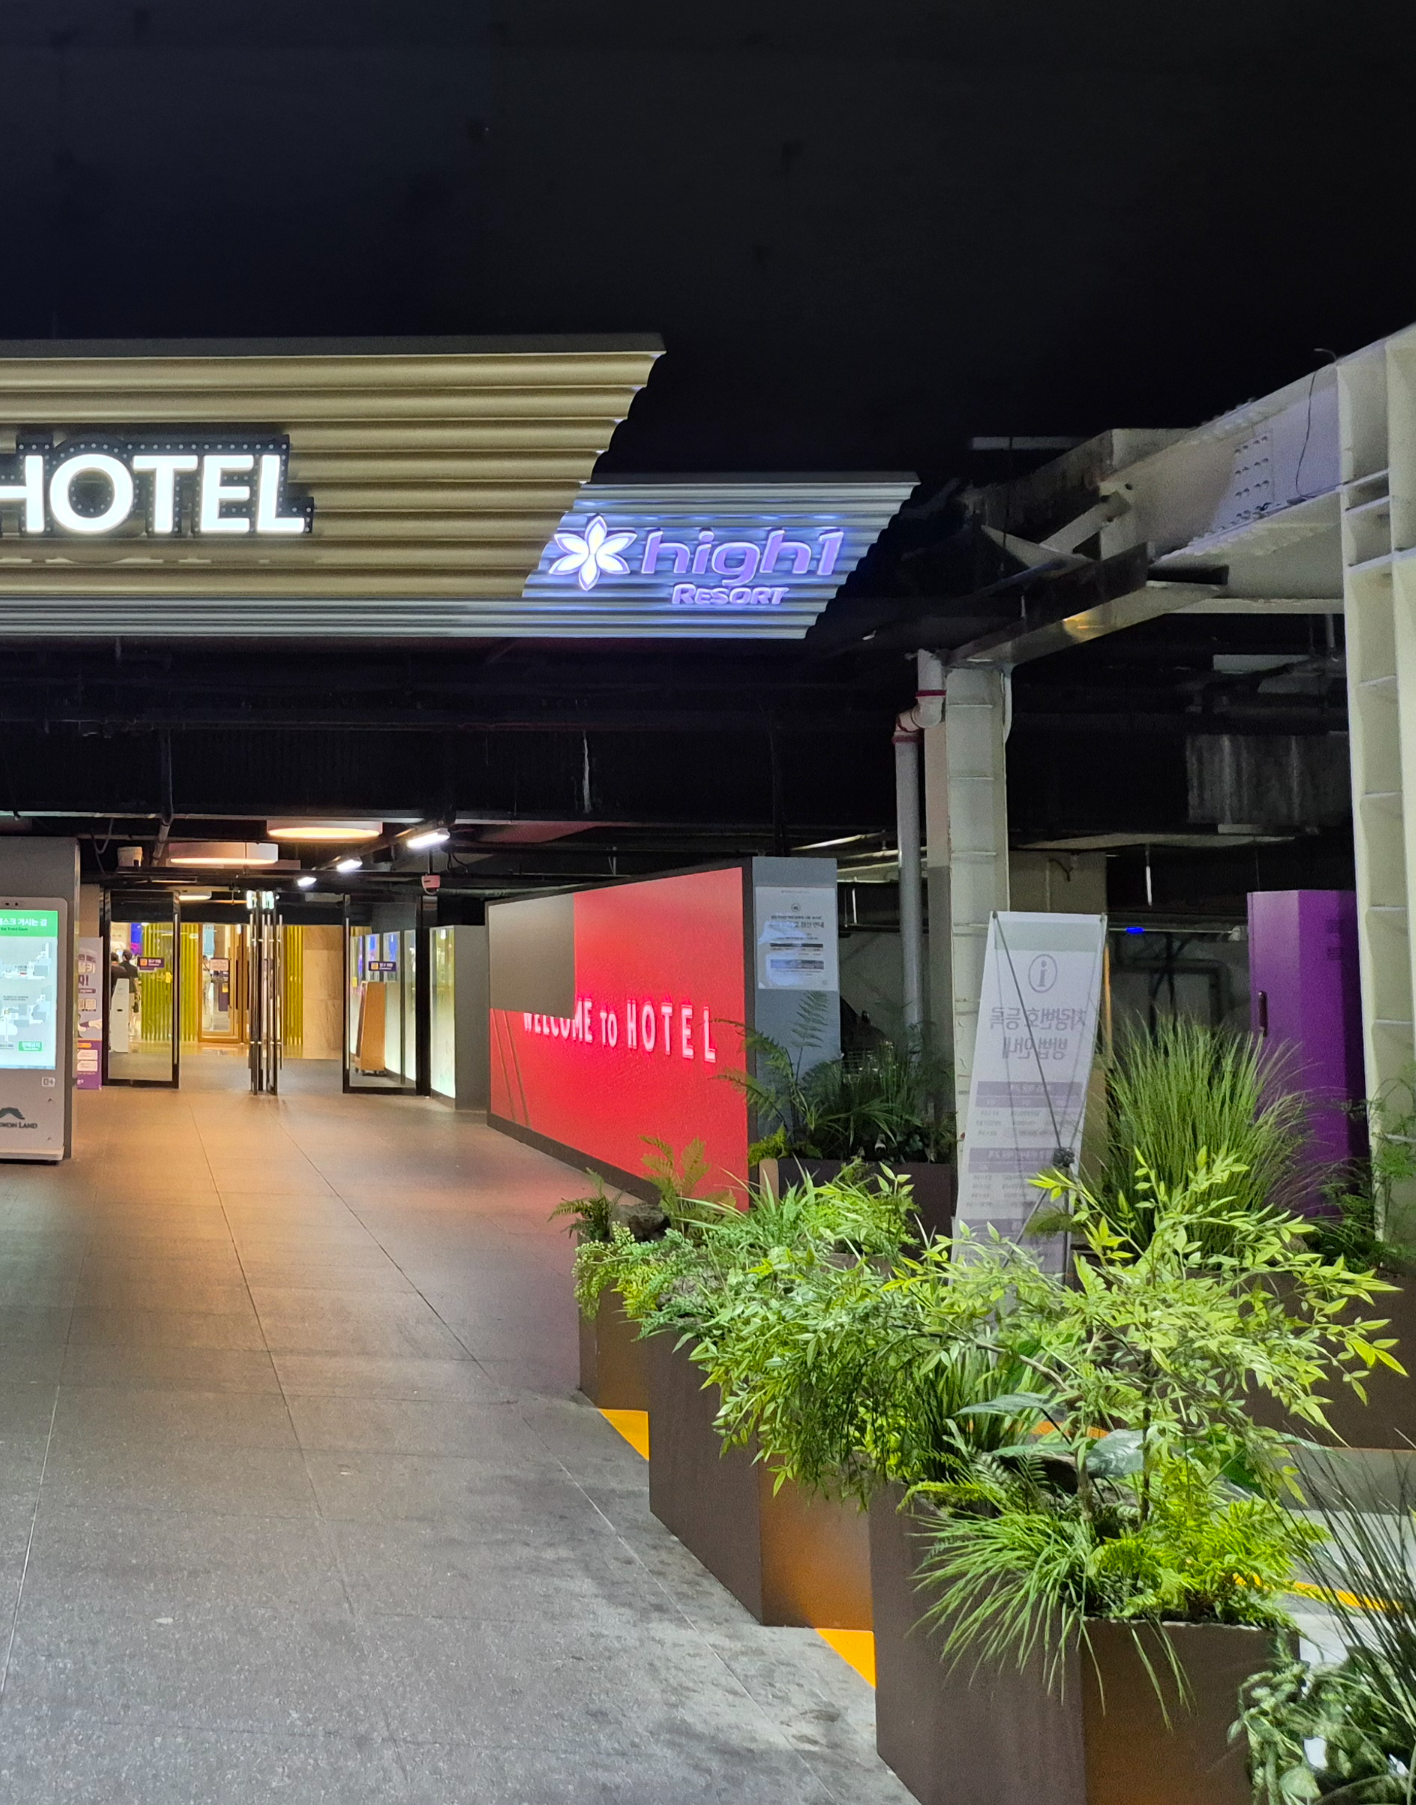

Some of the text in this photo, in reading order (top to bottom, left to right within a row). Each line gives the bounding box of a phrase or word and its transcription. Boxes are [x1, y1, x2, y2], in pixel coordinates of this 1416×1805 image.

[641, 529, 845, 587] high1
[671, 583, 790, 605] RESORT
[627, 999, 716, 1064] HOTEL
[18, 1121, 38, 1129] LAND
